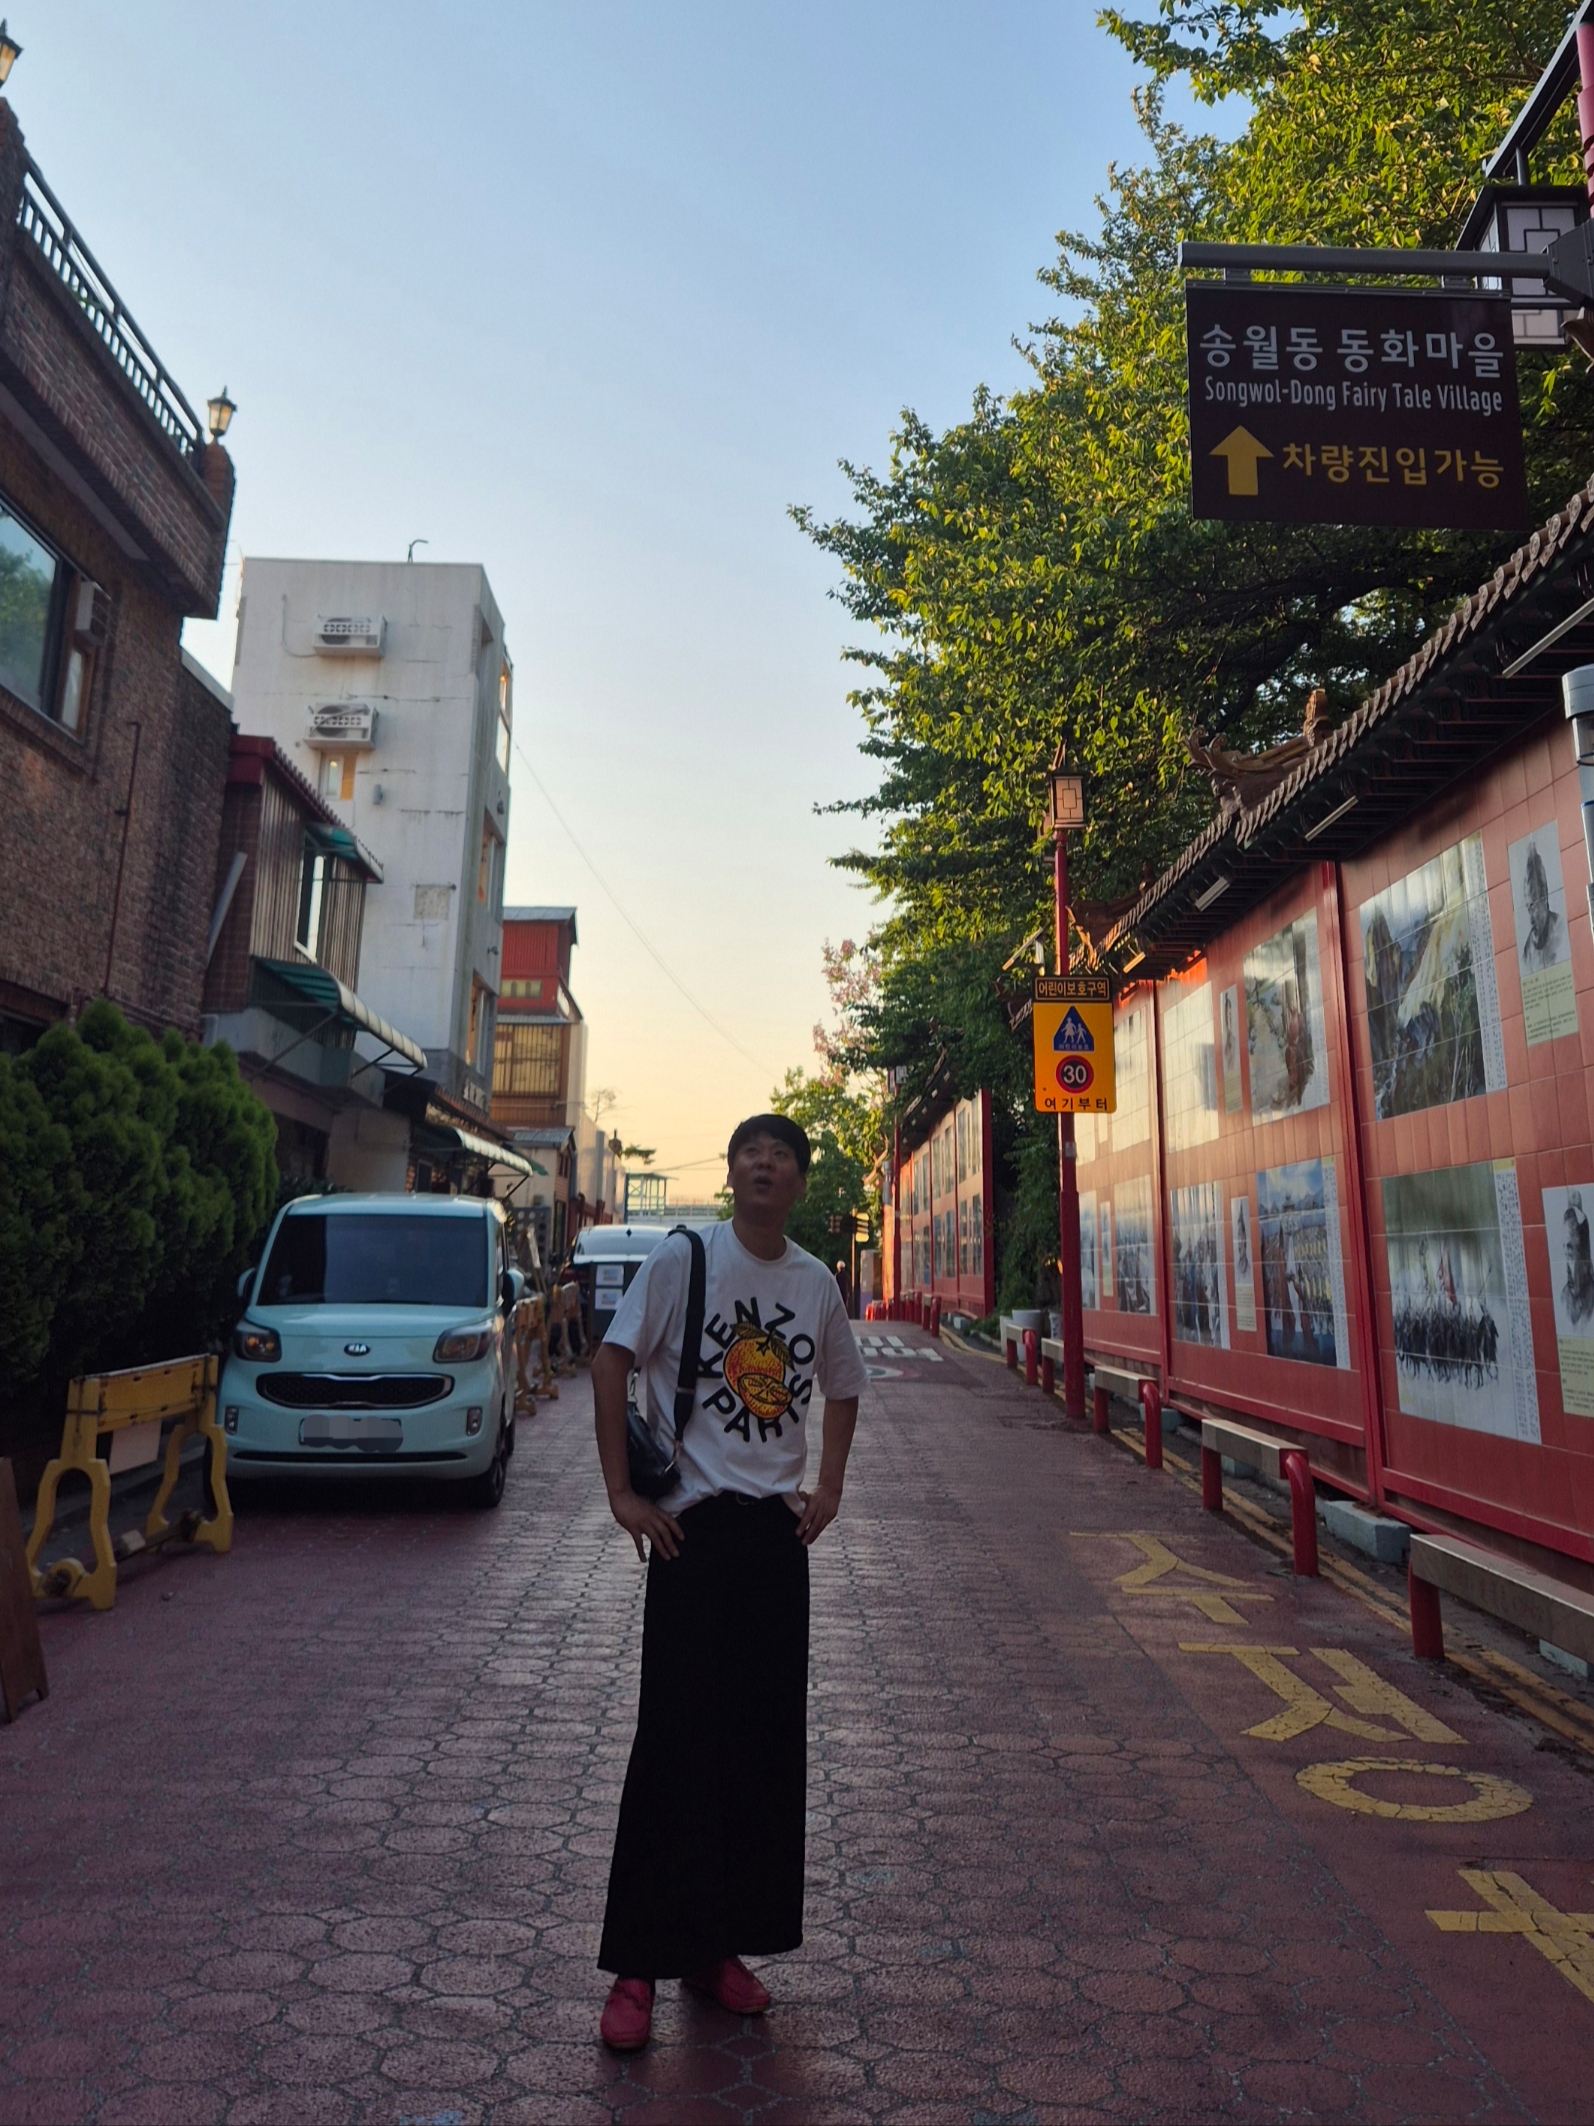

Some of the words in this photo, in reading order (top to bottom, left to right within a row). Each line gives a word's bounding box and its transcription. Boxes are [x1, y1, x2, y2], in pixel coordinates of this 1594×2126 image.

[1200, 324, 1323, 371] 송월동
[1337, 328, 1504, 378] 동화마을
[1205, 375, 1336, 411] Songwol-Dong
[1342, 381, 1387, 412] Fairy
[1392, 383, 1431, 410] Tale
[1436, 384, 1502, 416] Village
[1282, 443, 1504, 489] 차량진입가능
[1038, 981, 1107, 996] 어린이보호구역
[1063, 1065, 1087, 1084] 30
[1044, 1097, 1107, 1111] 여기부터
[697, 1296, 816, 1379] KENZO
